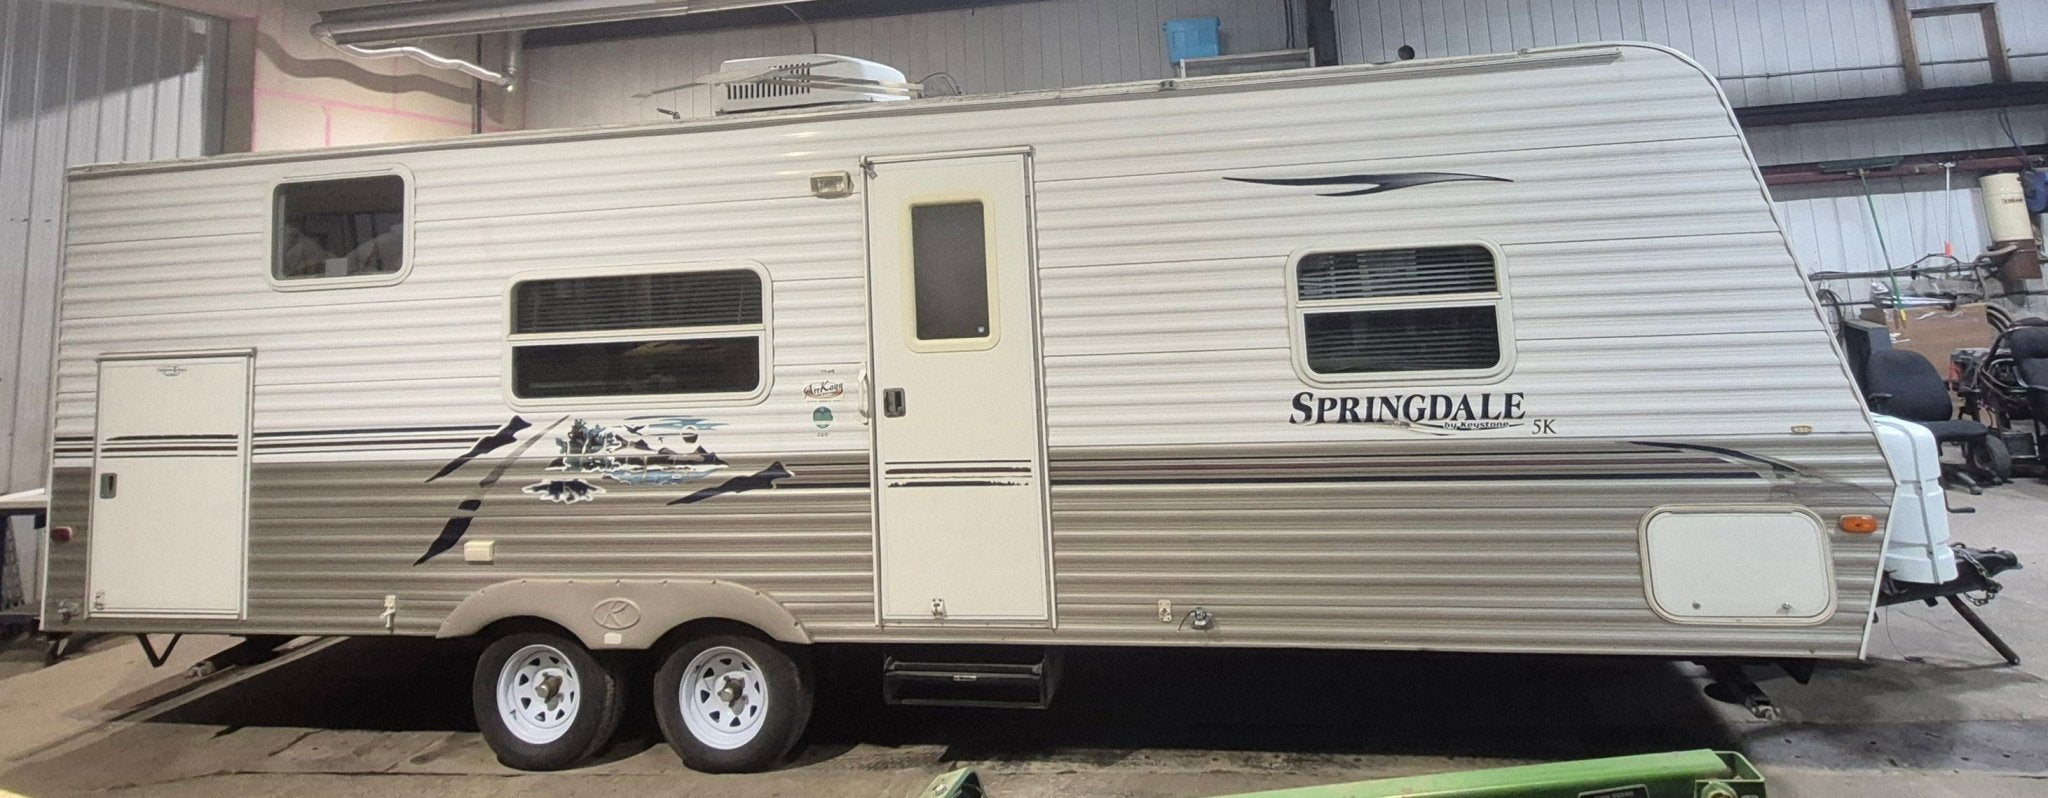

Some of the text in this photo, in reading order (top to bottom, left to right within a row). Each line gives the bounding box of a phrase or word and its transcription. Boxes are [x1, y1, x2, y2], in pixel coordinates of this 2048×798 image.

[1444, 421, 1510, 430] by Keystone
[1532, 419, 1557, 435] 5K
